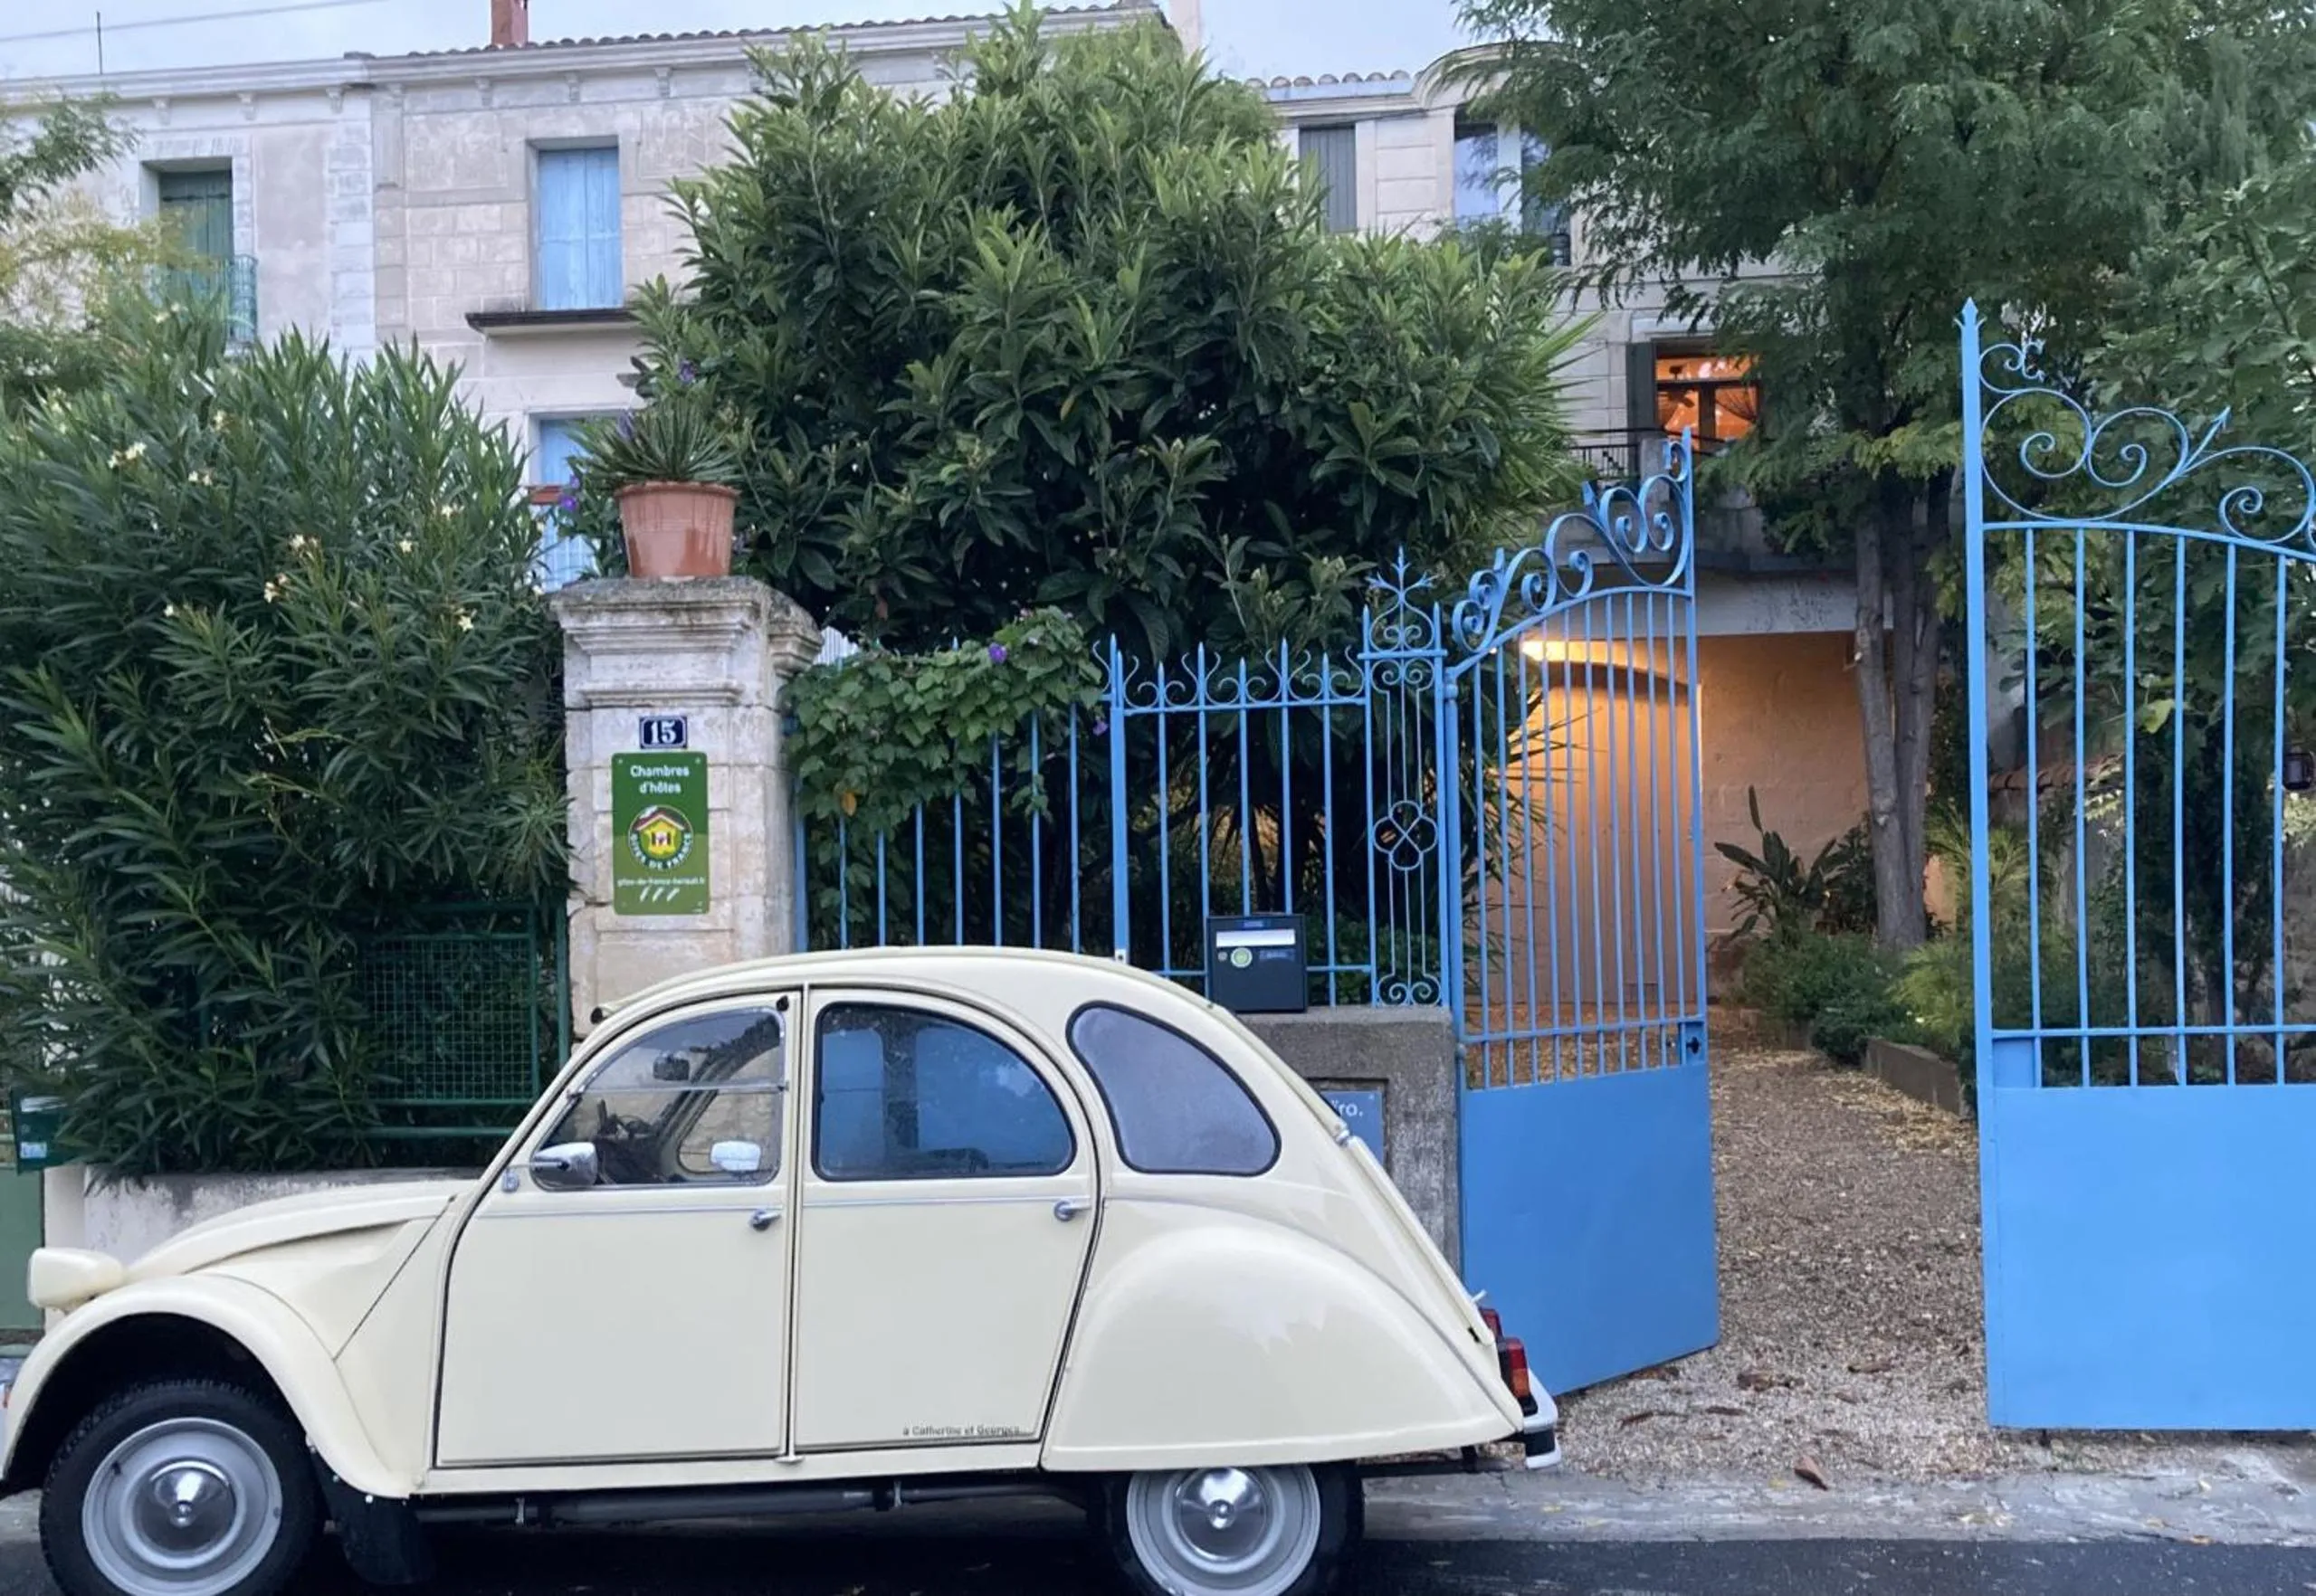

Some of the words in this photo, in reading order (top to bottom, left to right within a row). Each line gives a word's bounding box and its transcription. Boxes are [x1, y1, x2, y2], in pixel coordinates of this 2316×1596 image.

[651, 720, 676, 744] 15
[630, 765, 690, 777] Chambres
[639, 781, 681, 794] d'hôtes
